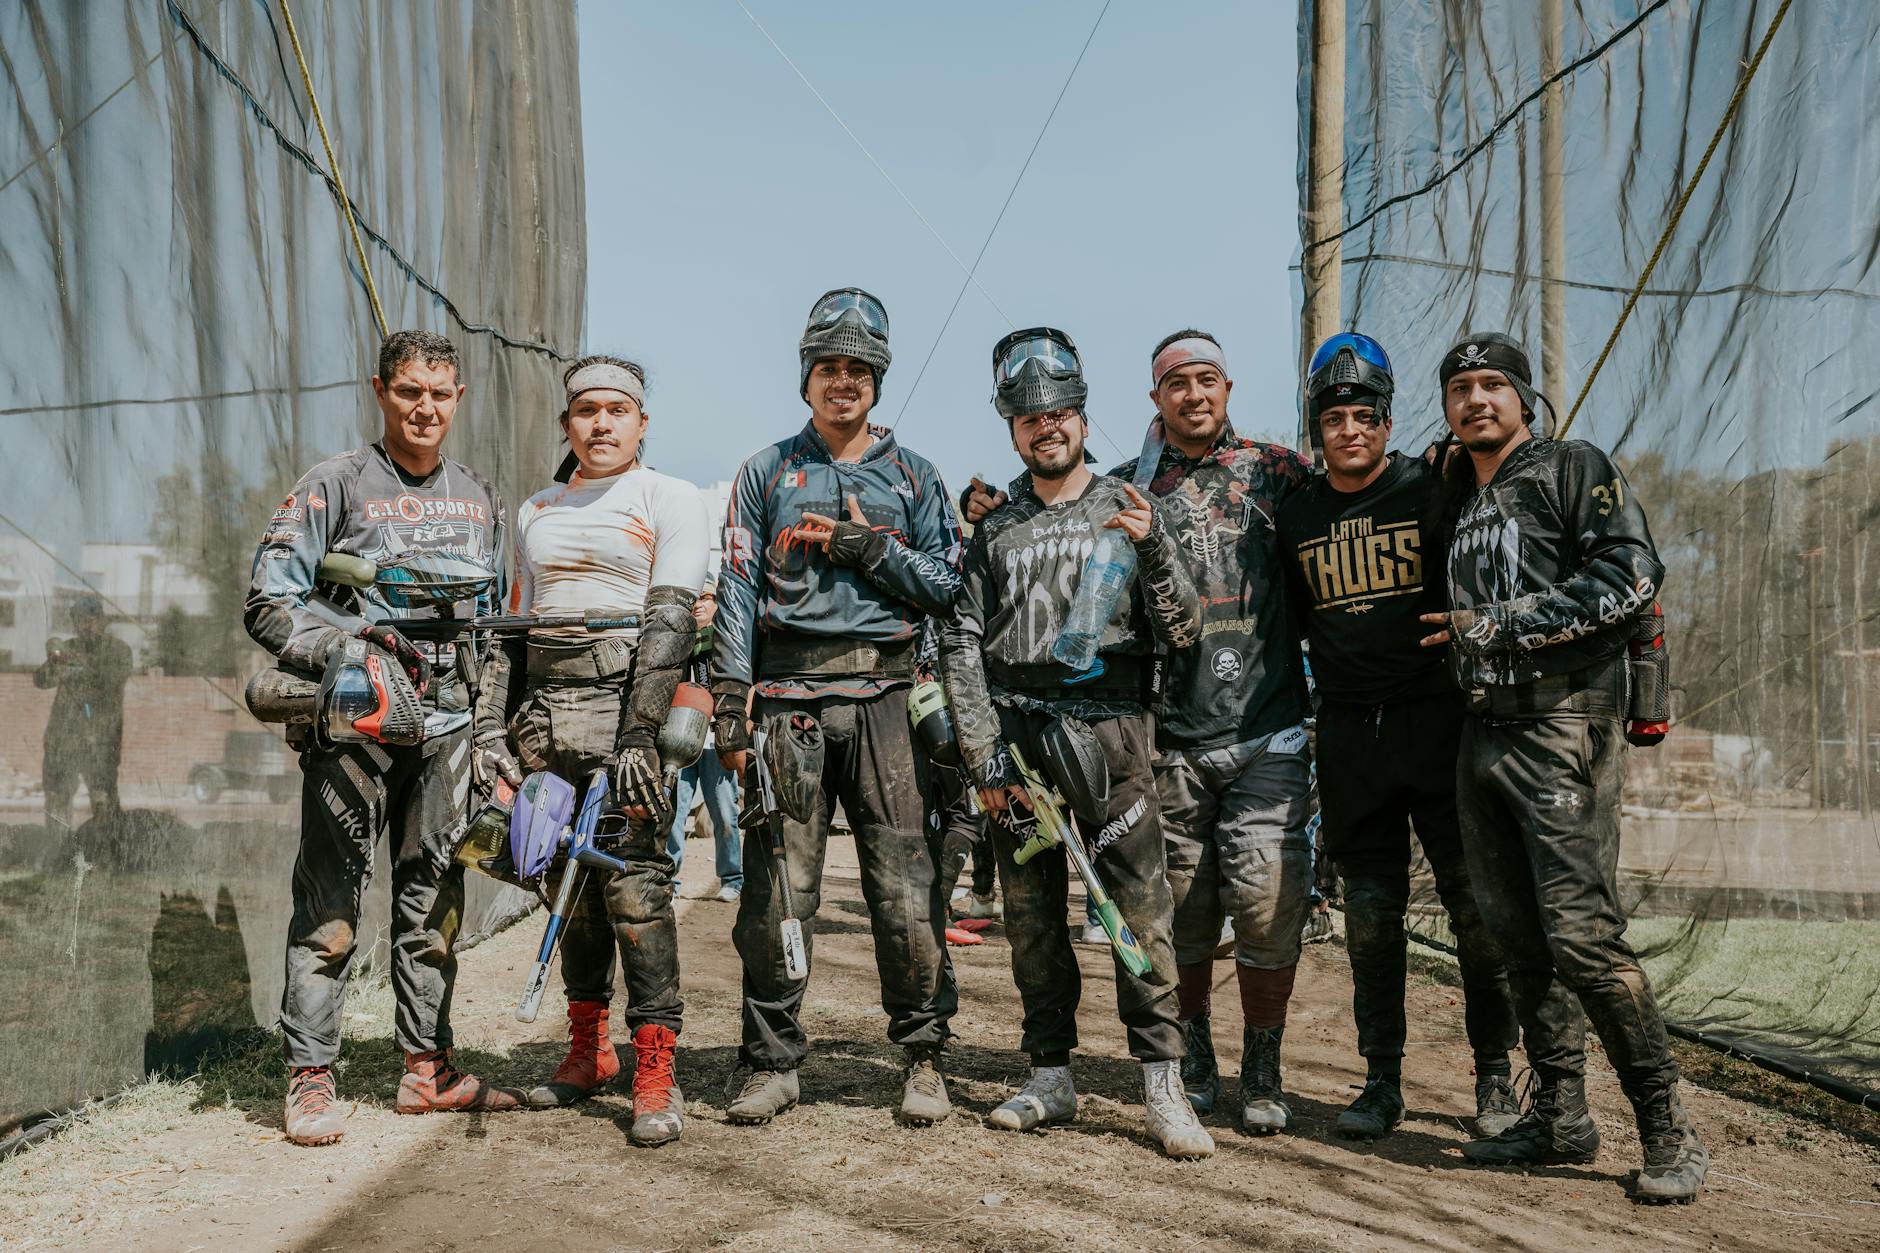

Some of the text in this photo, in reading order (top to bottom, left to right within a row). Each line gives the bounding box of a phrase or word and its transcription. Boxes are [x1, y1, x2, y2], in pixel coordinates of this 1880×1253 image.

[425, 500, 484, 520] SPORTZ
[1591, 478, 1625, 517] 31
[1330, 516, 1373, 542] LATIN
[1298, 529, 1422, 600] THUGS
[1517, 577, 1655, 651] Dark Side
